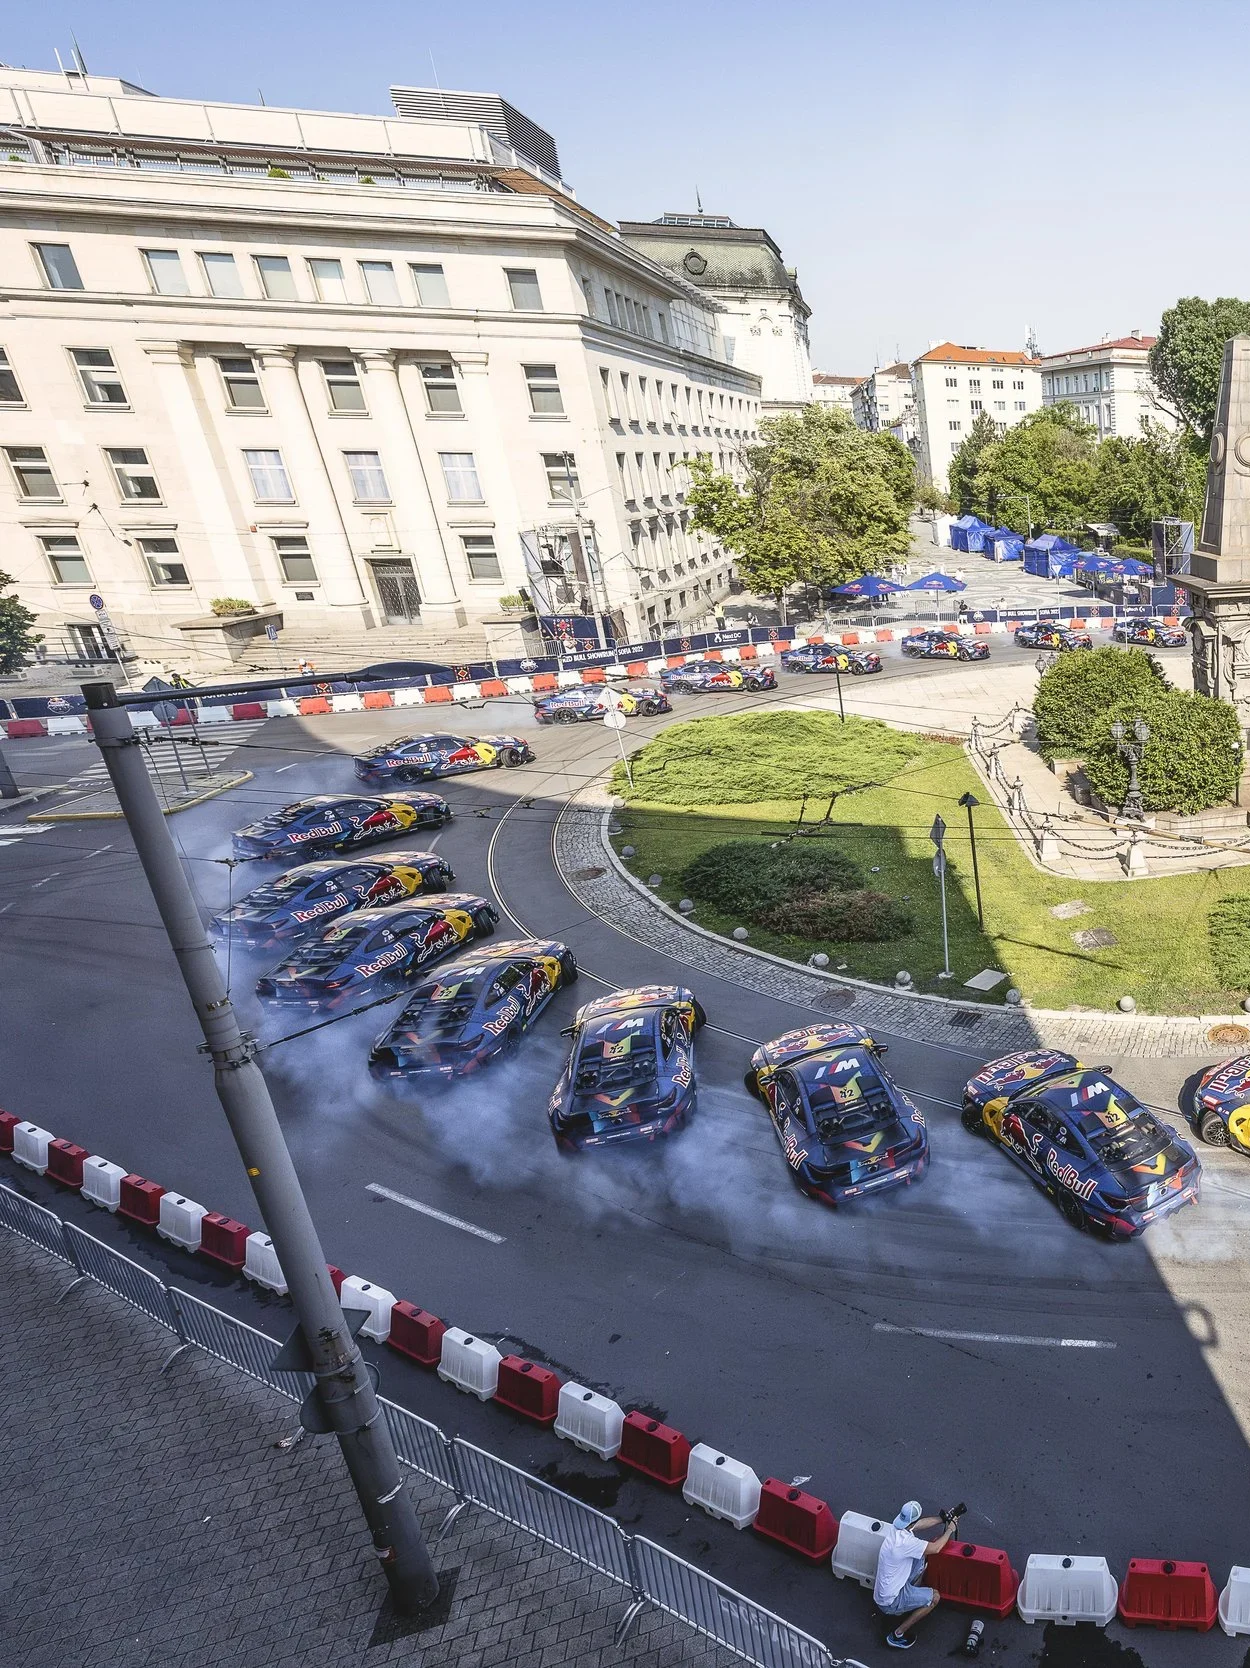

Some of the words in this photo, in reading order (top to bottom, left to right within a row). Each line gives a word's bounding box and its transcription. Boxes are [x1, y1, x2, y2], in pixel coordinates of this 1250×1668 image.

[618, 648, 631, 656] SOFIA
[386, 755, 410, 768] Red
[408, 752, 431, 765] Bull
[287, 828, 319, 844] Red
[316, 821, 343, 838] Bull
[291, 902, 325, 923] Red
[322, 892, 349, 914] Bull
[354, 954, 391, 979] Red
[386, 942, 408, 967] Bull
[482, 1009, 511, 1036] Red
[503, 995, 520, 1021] Bull
[1046, 1148, 1071, 1184] Red
[1065, 1168, 1098, 1201] Bull
